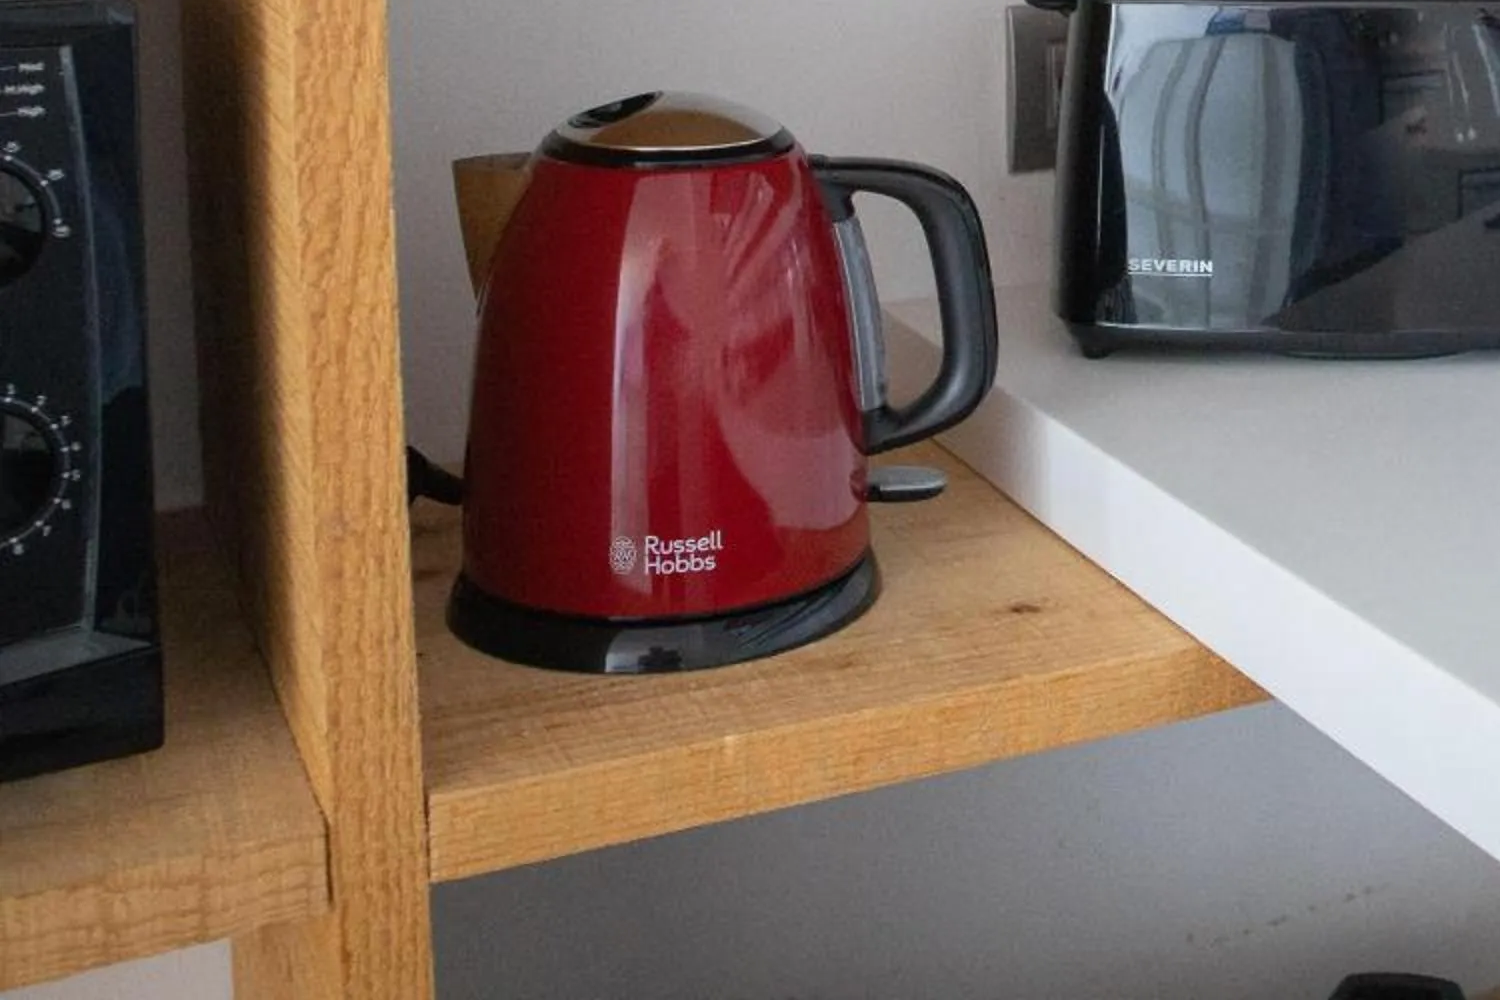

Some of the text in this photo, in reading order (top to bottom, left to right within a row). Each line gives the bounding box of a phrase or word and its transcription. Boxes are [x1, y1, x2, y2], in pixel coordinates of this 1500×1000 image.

[1127, 258, 1213, 274] SEVERIN
[644, 529, 723, 555] Russell
[644, 554, 717, 575] Hobbs
